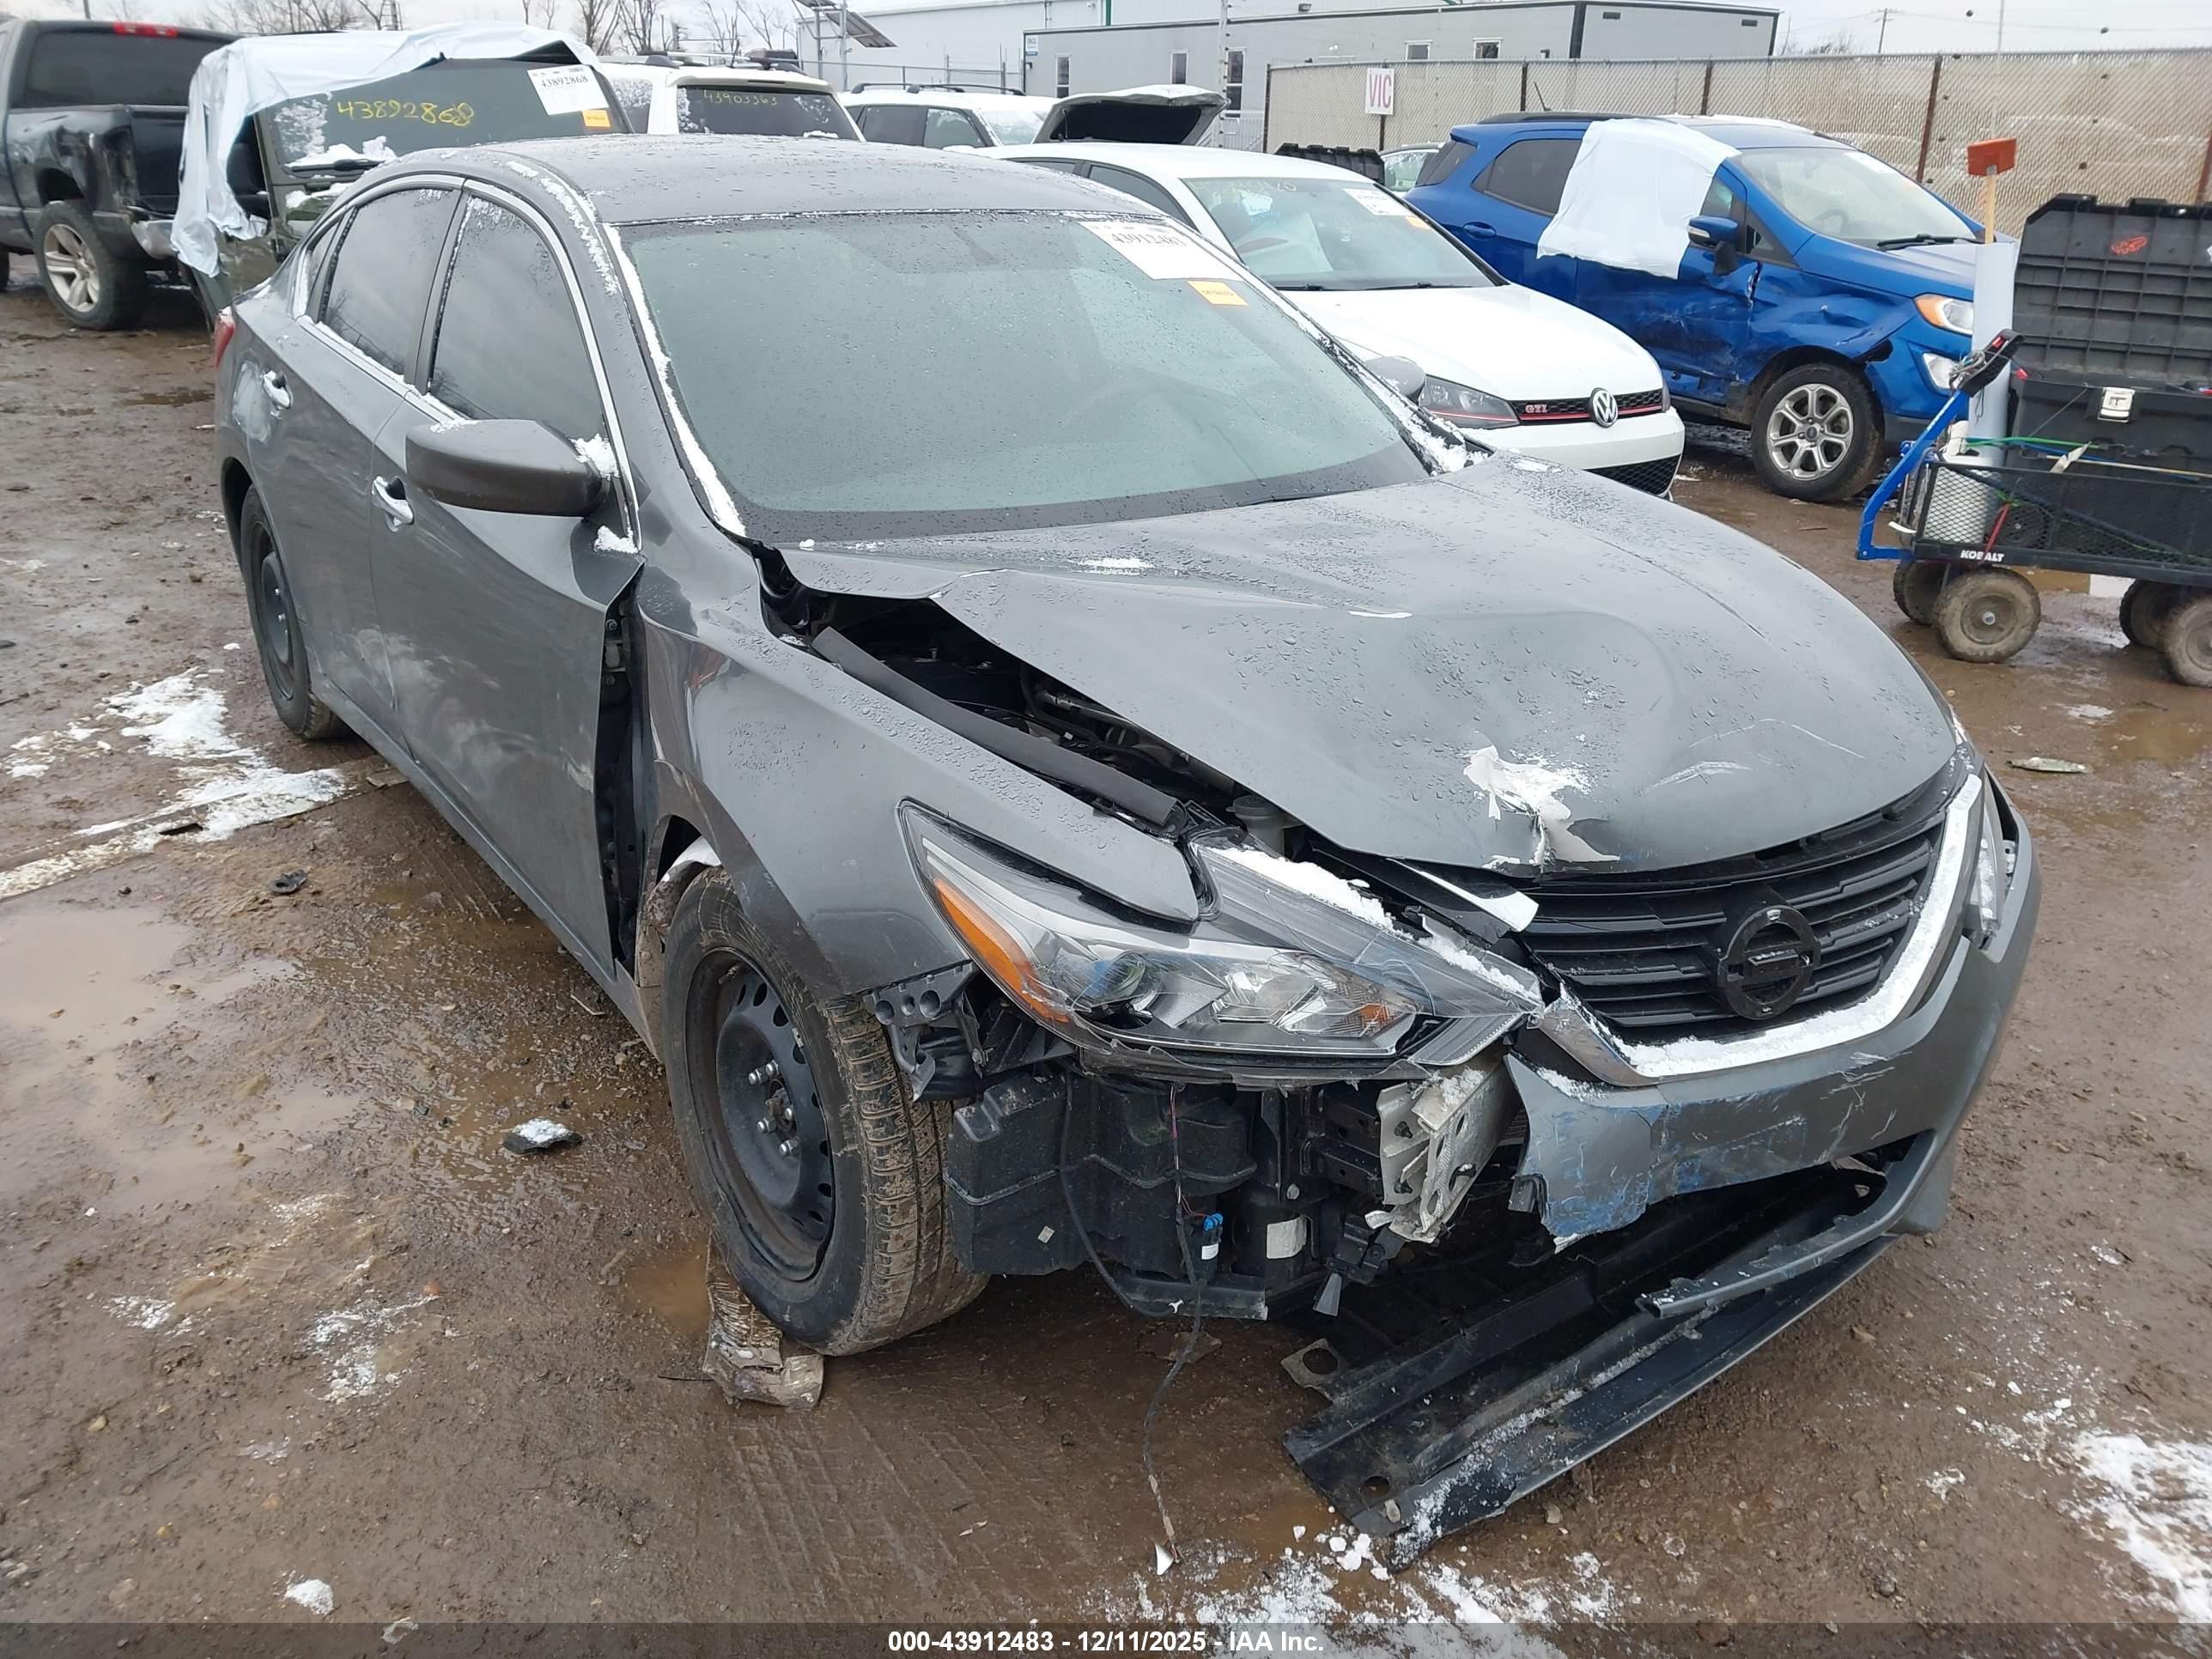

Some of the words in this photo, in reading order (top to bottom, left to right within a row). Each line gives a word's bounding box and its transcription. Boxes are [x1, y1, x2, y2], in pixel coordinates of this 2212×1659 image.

[1369, 74, 1392, 108] VIC
[337, 99, 475, 126] 43892868
[1525, 404, 1547, 414] GTI
[1960, 550, 2005, 562] KOBALT
